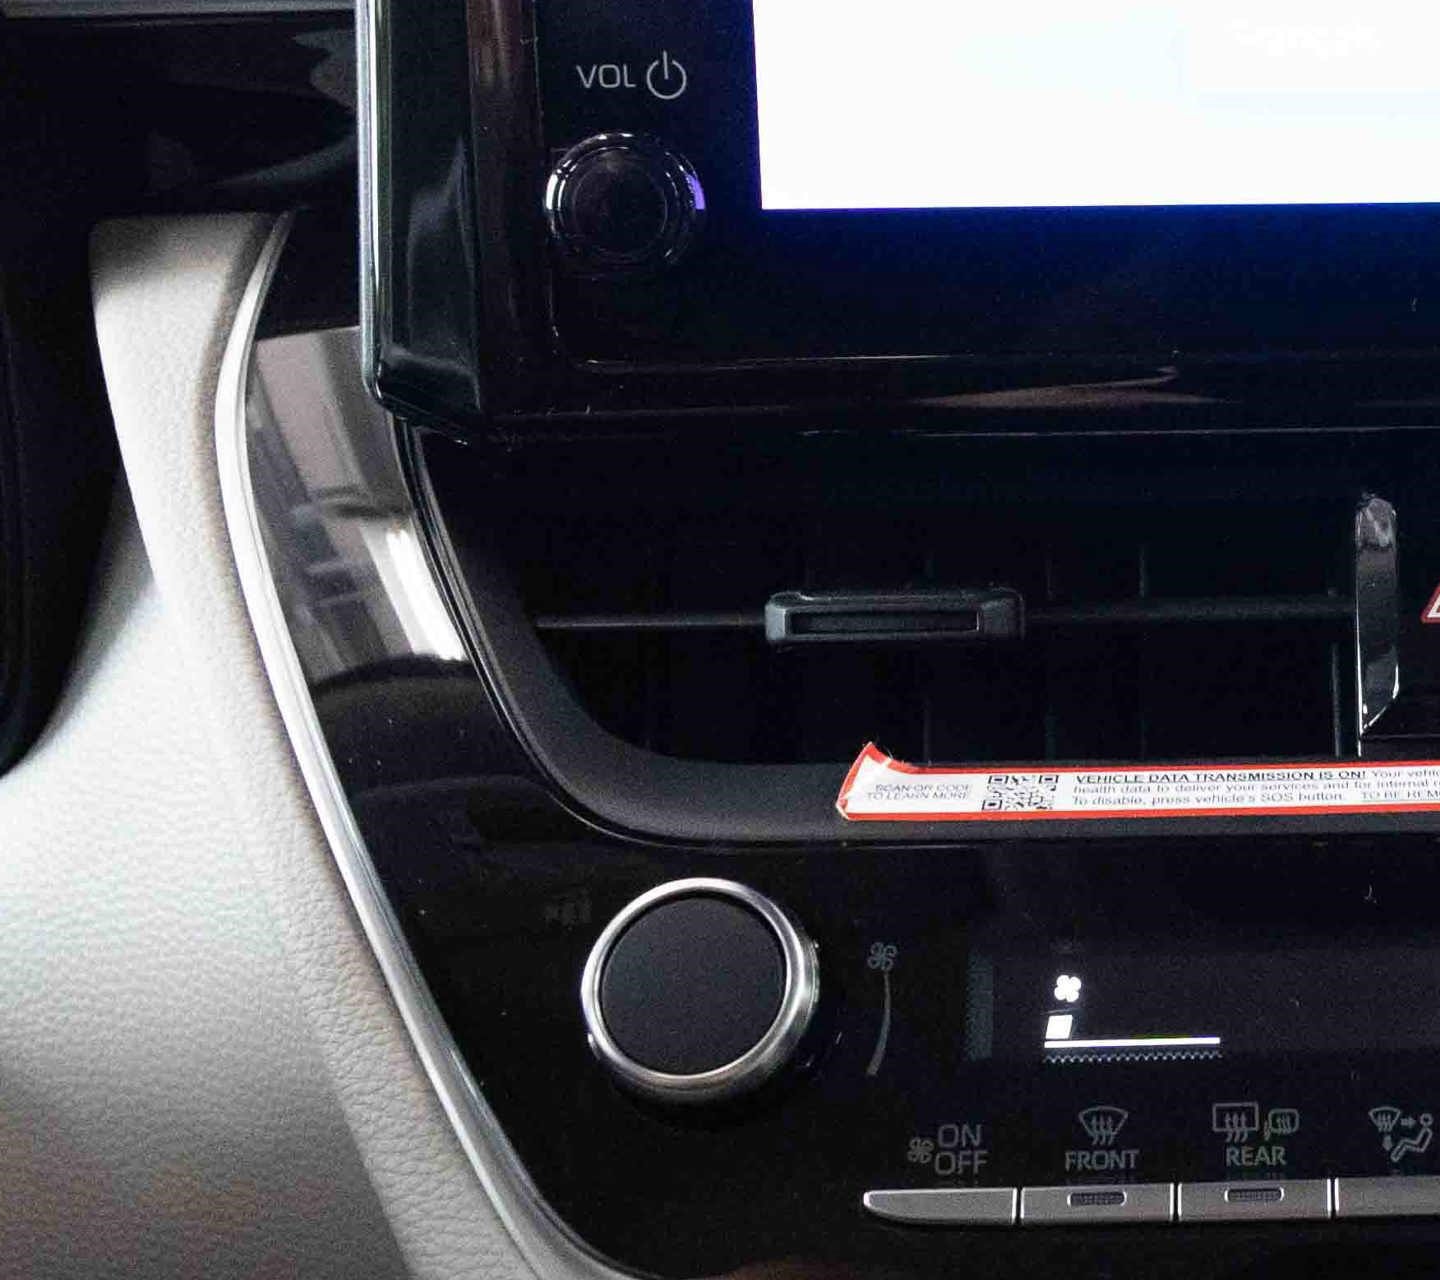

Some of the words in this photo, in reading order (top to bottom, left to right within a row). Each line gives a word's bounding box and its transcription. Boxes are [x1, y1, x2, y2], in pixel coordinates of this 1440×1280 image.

[576, 64, 637, 89] VOL
[1076, 773, 1142, 784] VEHICLE
[1149, 773, 1189, 784] DATA
[1195, 771, 1315, 783] TRANSMISSION
[1318, 771, 1333, 780] IS
[1338, 770, 1366, 780] ON!
[1261, 792, 1294, 802] SOS
[938, 1123, 983, 1147] ON
[935, 1150, 990, 1176] OFF
[1064, 1147, 1139, 1172] FRONT
[1225, 1145, 1286, 1169] REAR
